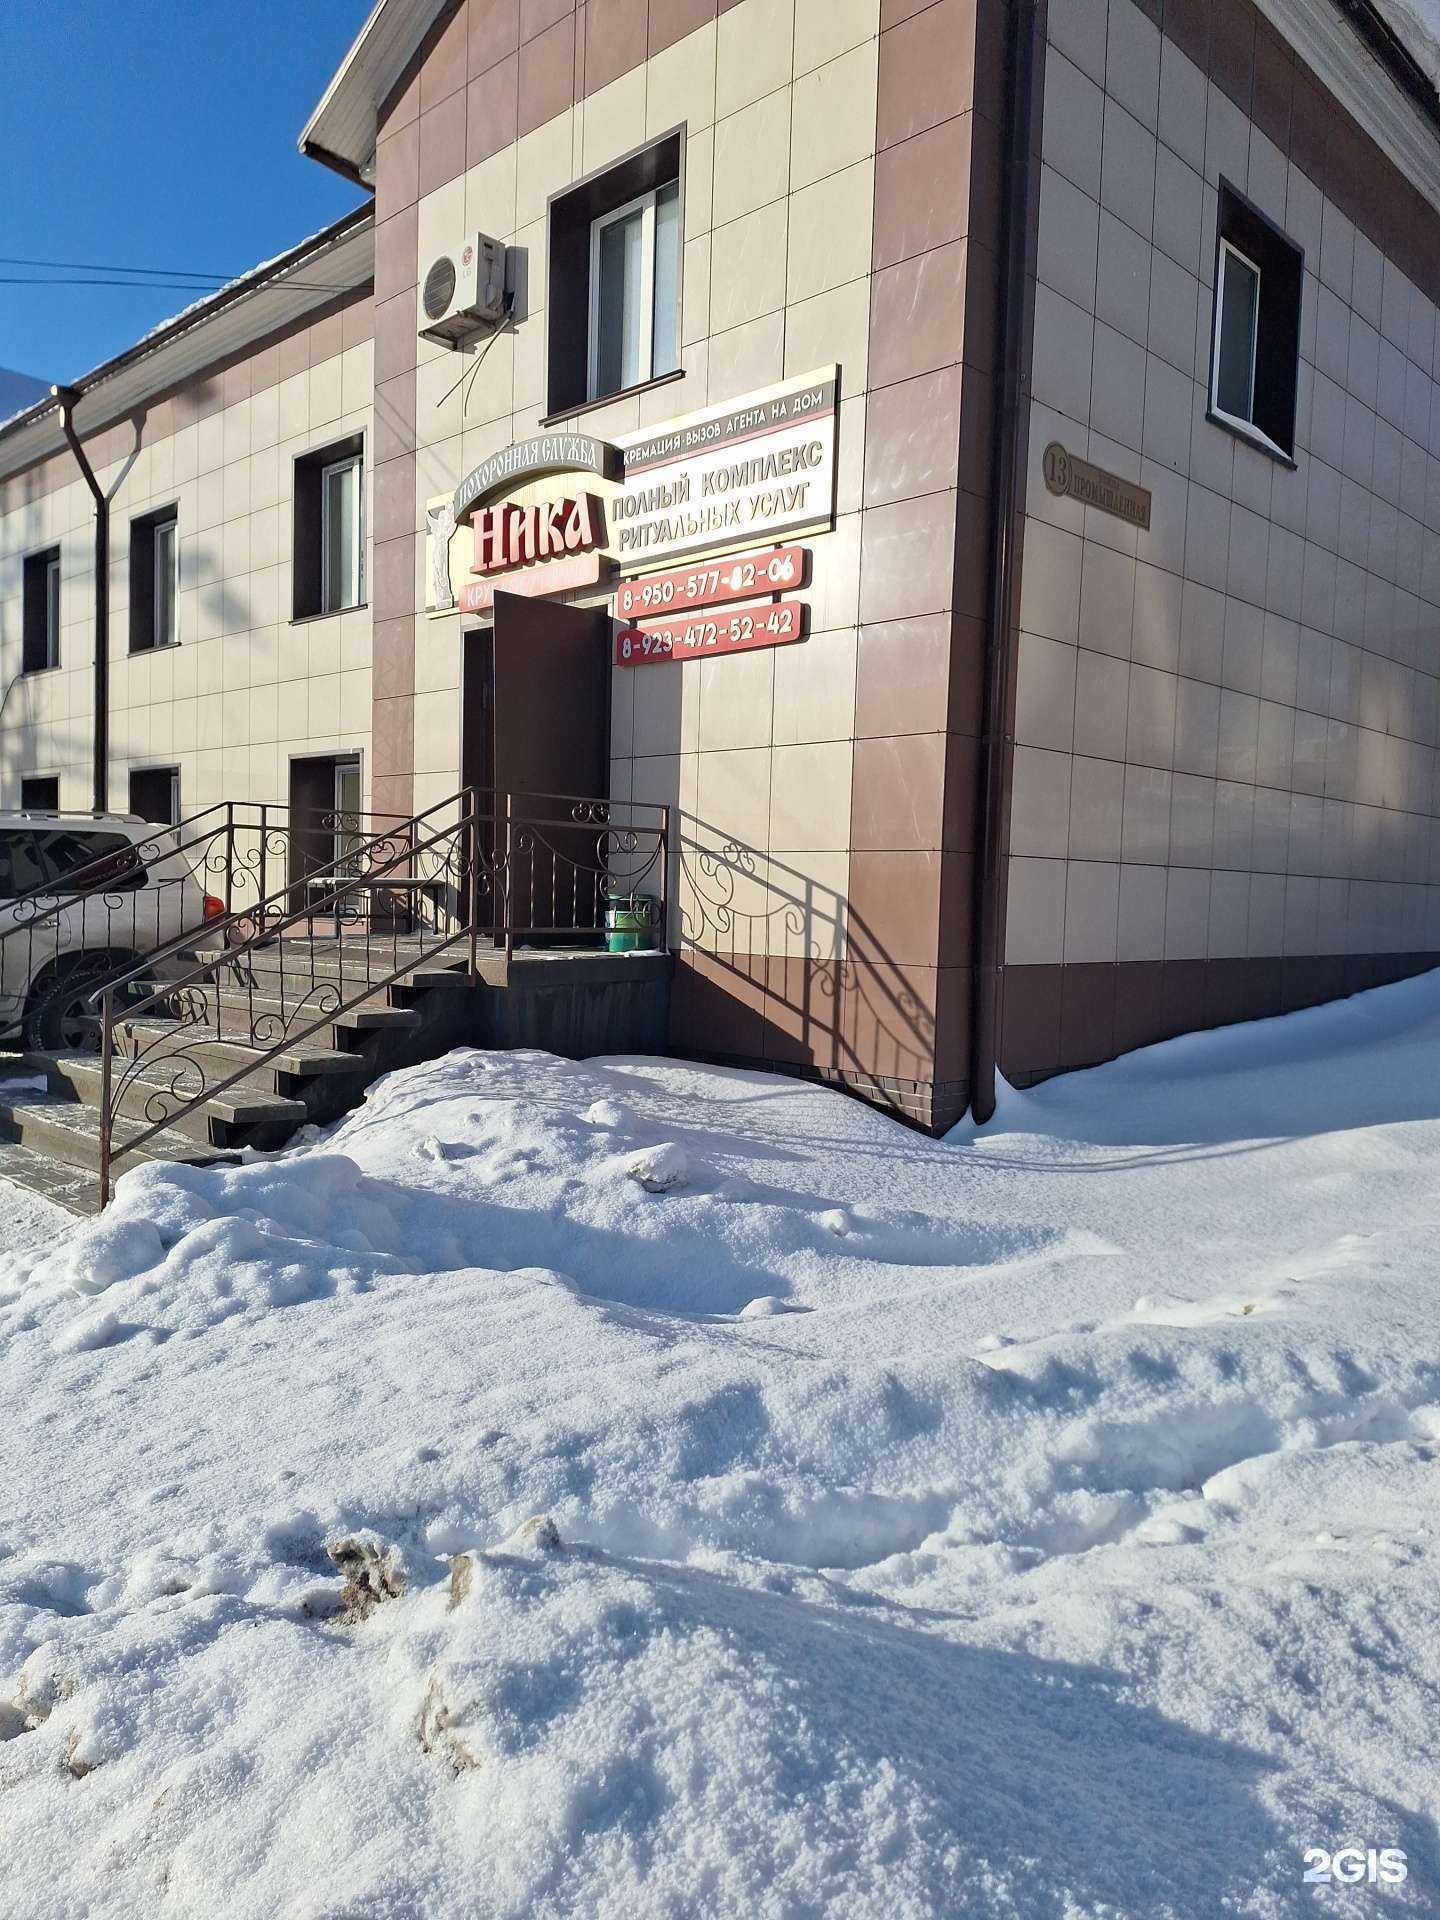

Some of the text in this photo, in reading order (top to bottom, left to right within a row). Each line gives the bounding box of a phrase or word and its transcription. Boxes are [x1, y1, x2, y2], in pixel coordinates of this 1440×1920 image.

[623, 389, 824, 466] КРЕМАЦИЯ ВЫЗОВ АГЕНТА НА ДОМ
[458, 436, 599, 509] ПОХОРОННАЯ СЛУЖБА
[612, 440, 823, 522] ПОЛНЫЙ КОМПЛЕКС
[1049, 452, 1067, 486] 13
[619, 482, 810, 551] РИТУАЛЬНЫХ УСЛУГ
[623, 552, 795, 611] 8-950-577-82-06
[622, 608, 794, 659] 8-923-472-52-42
